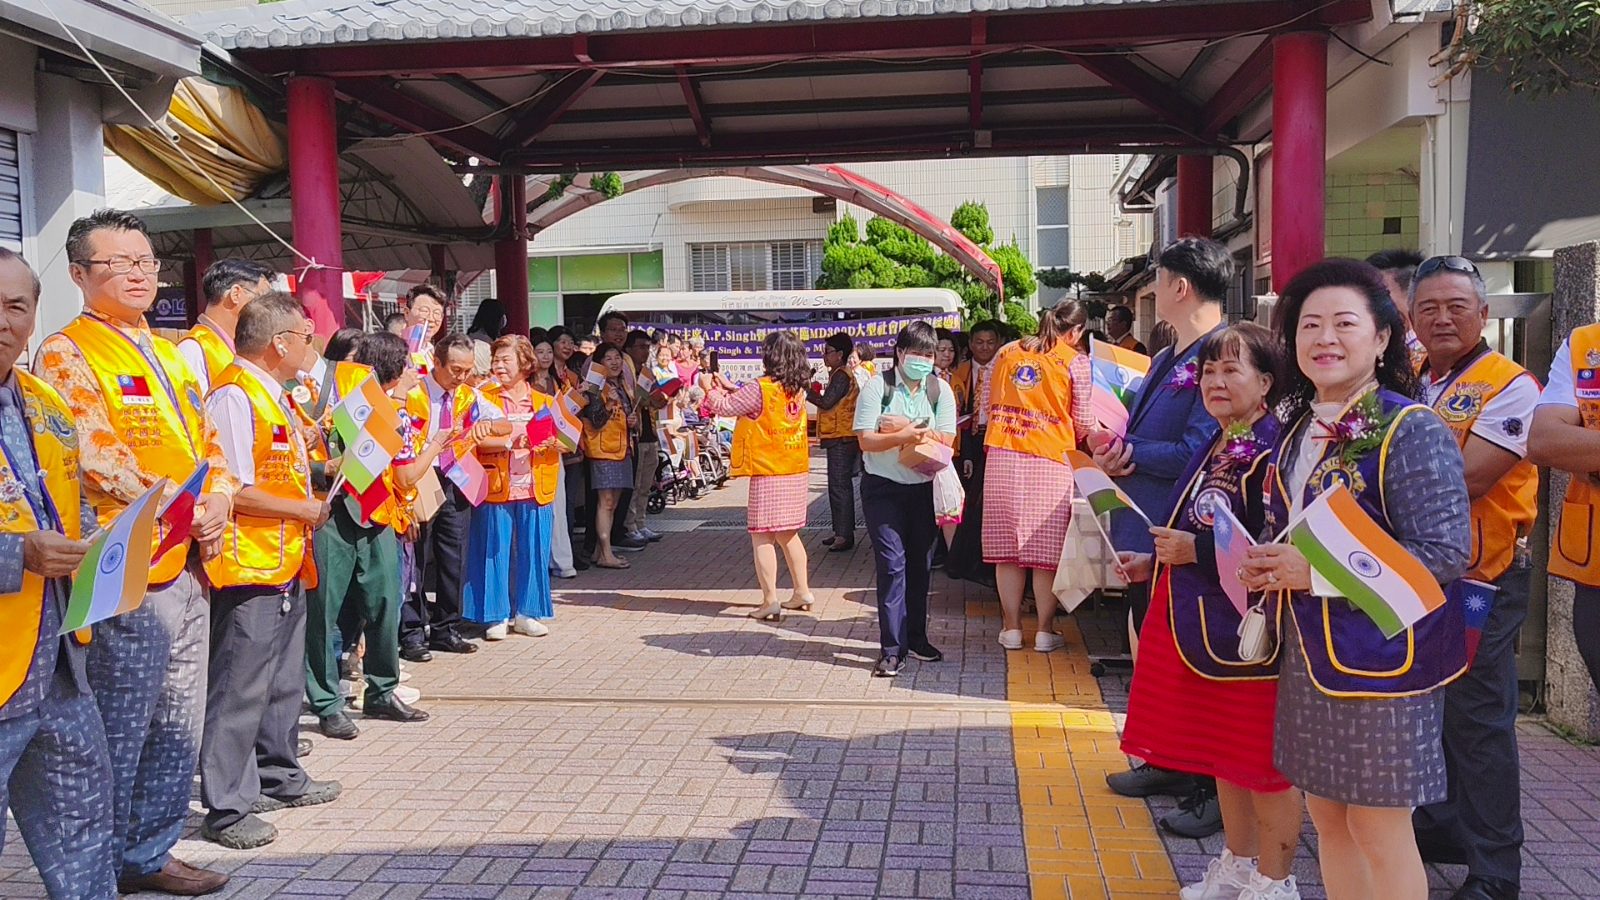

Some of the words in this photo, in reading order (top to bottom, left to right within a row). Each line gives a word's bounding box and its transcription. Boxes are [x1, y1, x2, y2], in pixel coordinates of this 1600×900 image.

[791, 295, 809, 306] We
[812, 295, 843, 307] Serve
[744, 346, 753, 354] &
[1001, 426, 1026, 437] TAIWAN
